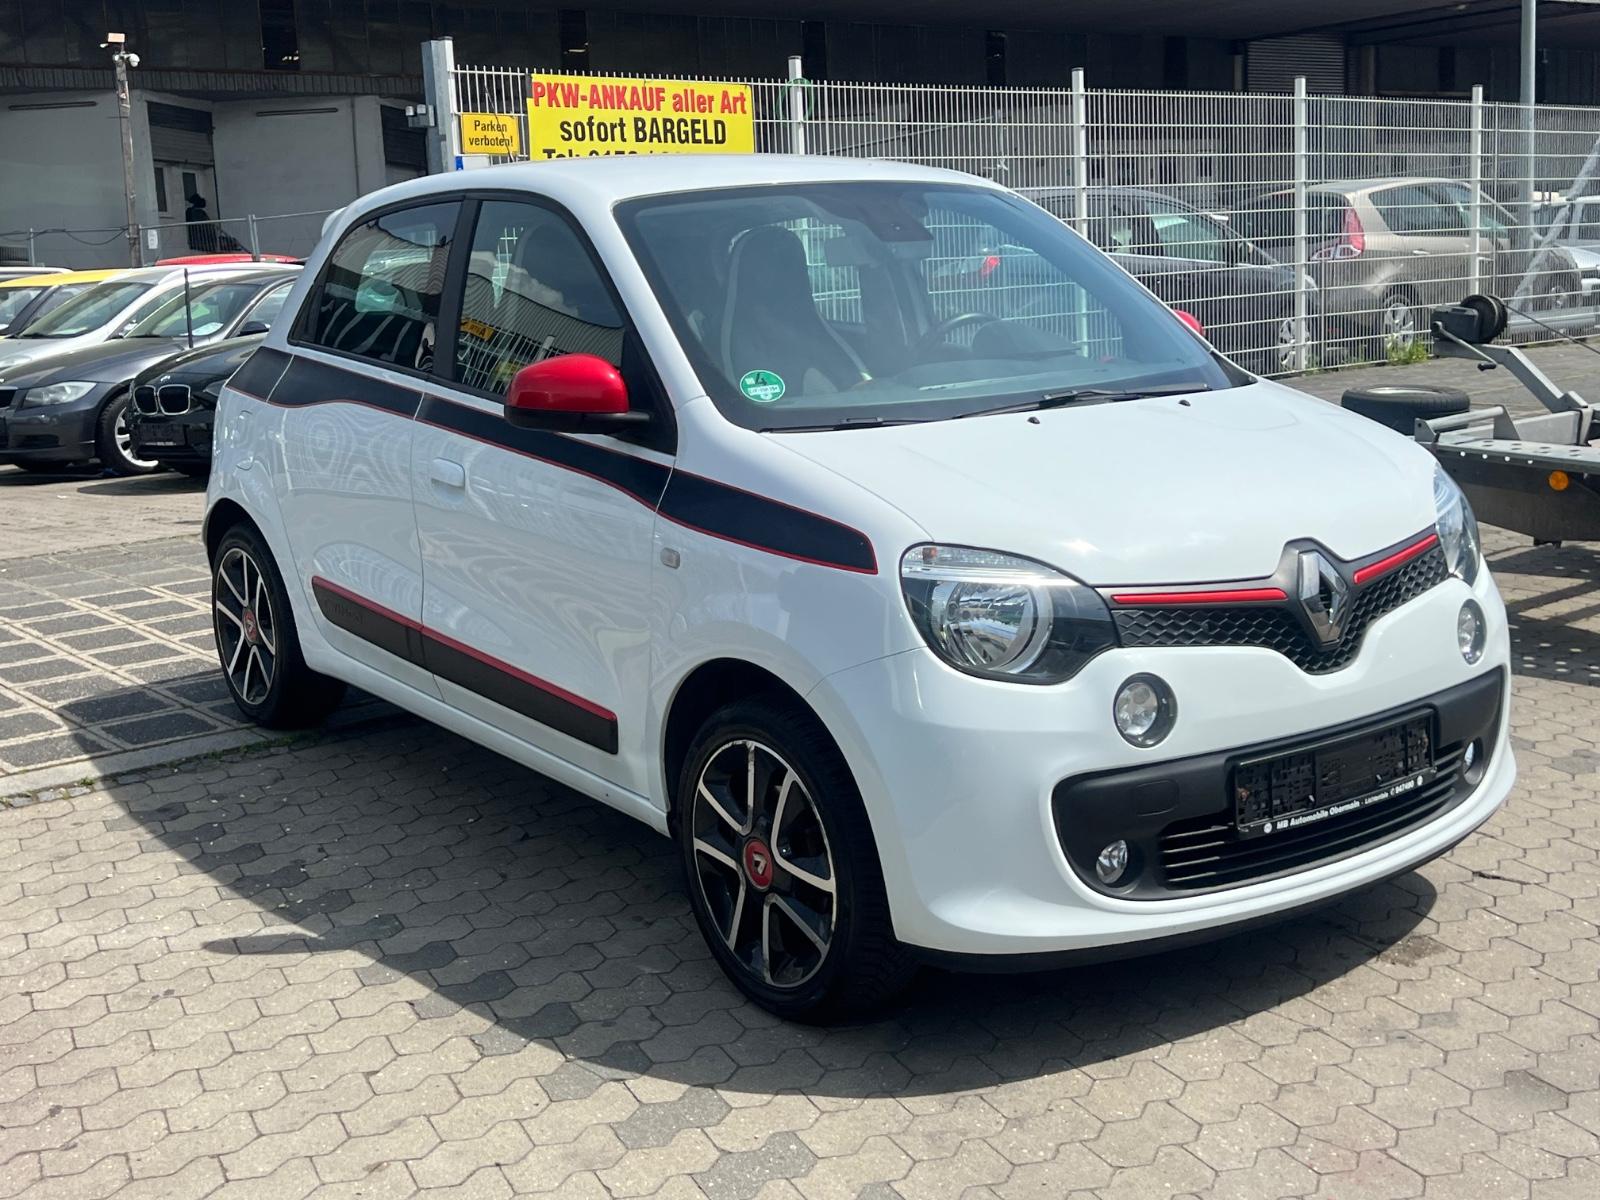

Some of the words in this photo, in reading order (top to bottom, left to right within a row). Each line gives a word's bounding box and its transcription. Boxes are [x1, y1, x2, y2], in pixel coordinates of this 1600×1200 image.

[532, 81, 666, 111] PKW-ANKAUF
[672, 88, 714, 113] aller
[720, 90, 747, 114] Art
[474, 119, 508, 132] Parken
[559, 115, 627, 143] sofort
[633, 116, 727, 145] BARGELD
[468, 134, 514, 148] verboten!
[1289, 810, 1329, 827] Automobile
